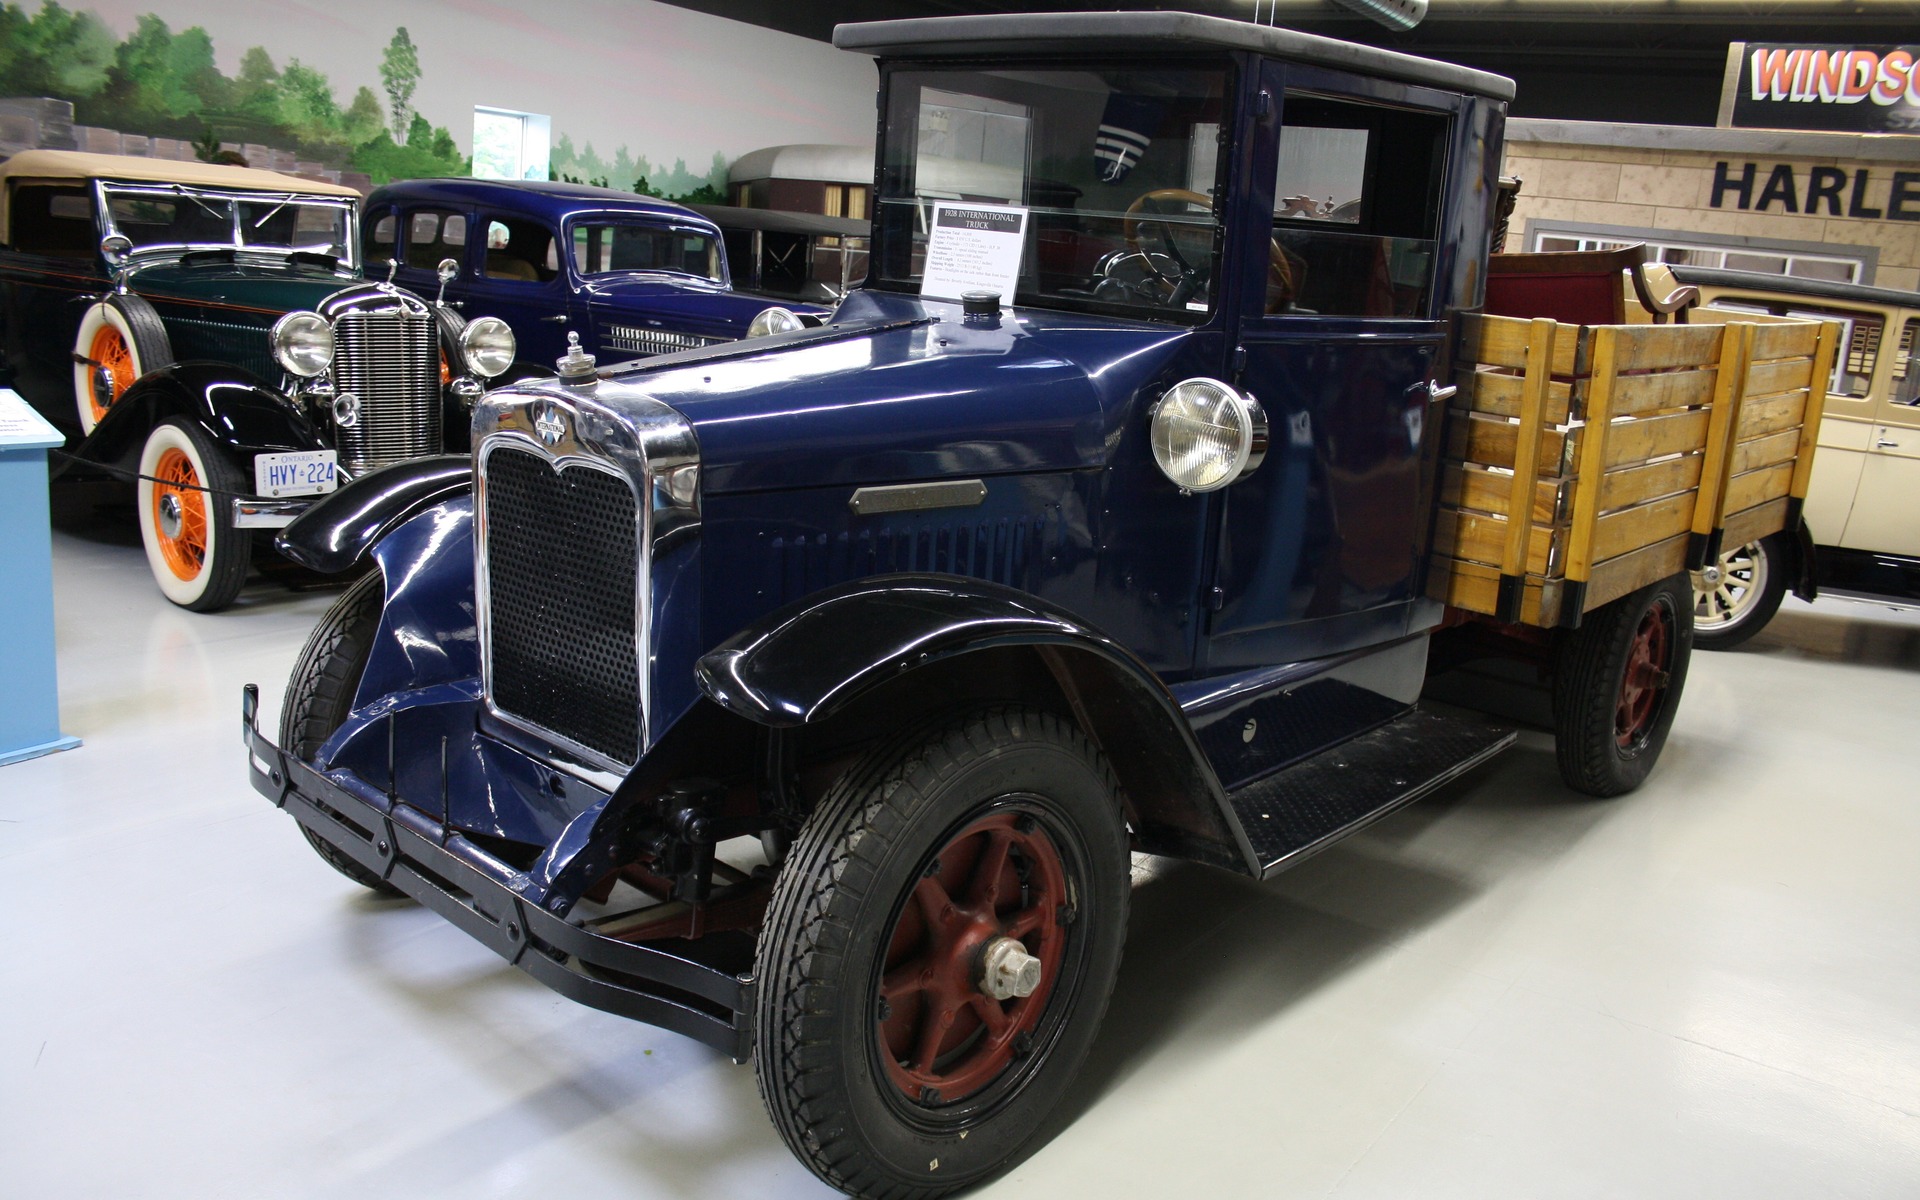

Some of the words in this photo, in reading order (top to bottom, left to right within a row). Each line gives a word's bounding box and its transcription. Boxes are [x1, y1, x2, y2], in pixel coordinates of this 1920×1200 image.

[1710, 161, 1920, 221] HARLE
[944, 209, 958, 217] 1928
[958, 210, 1015, 222] INTERNATIONAL
[966, 220, 989, 230] TRUCK
[281, 455, 313, 463] ONTARIO
[269, 464, 297, 486] HVY
[307, 462, 334, 484] 224
